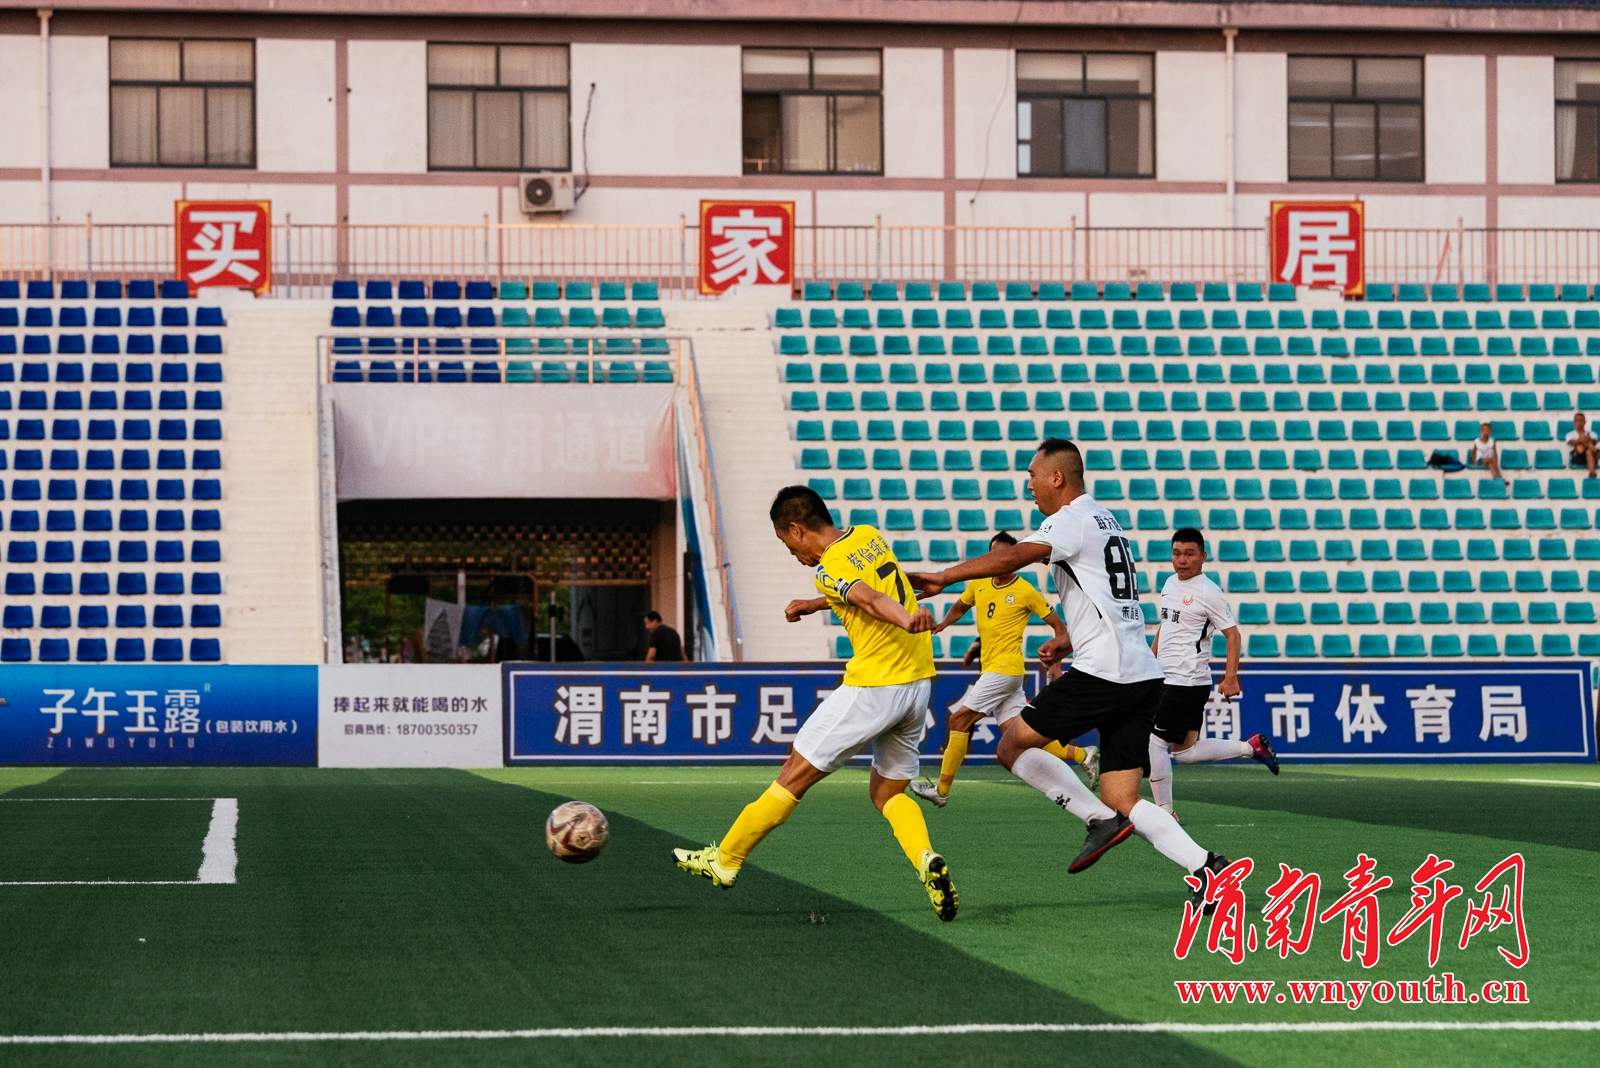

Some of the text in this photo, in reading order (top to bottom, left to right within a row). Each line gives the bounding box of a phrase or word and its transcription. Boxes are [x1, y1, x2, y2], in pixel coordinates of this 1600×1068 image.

[187, 211, 260, 283] 买
[710, 209, 785, 284] 家
[1280, 211, 1356, 284] 居
[362, 411, 650, 473] VIP专用通道
[875, 561, 906, 606] 7
[987, 602, 996, 619] 8
[39, 687, 201, 734] 子午玉露
[205, 720, 298, 734] （包装饮用水）
[333, 696, 488, 713] 捧起来就能喝的水
